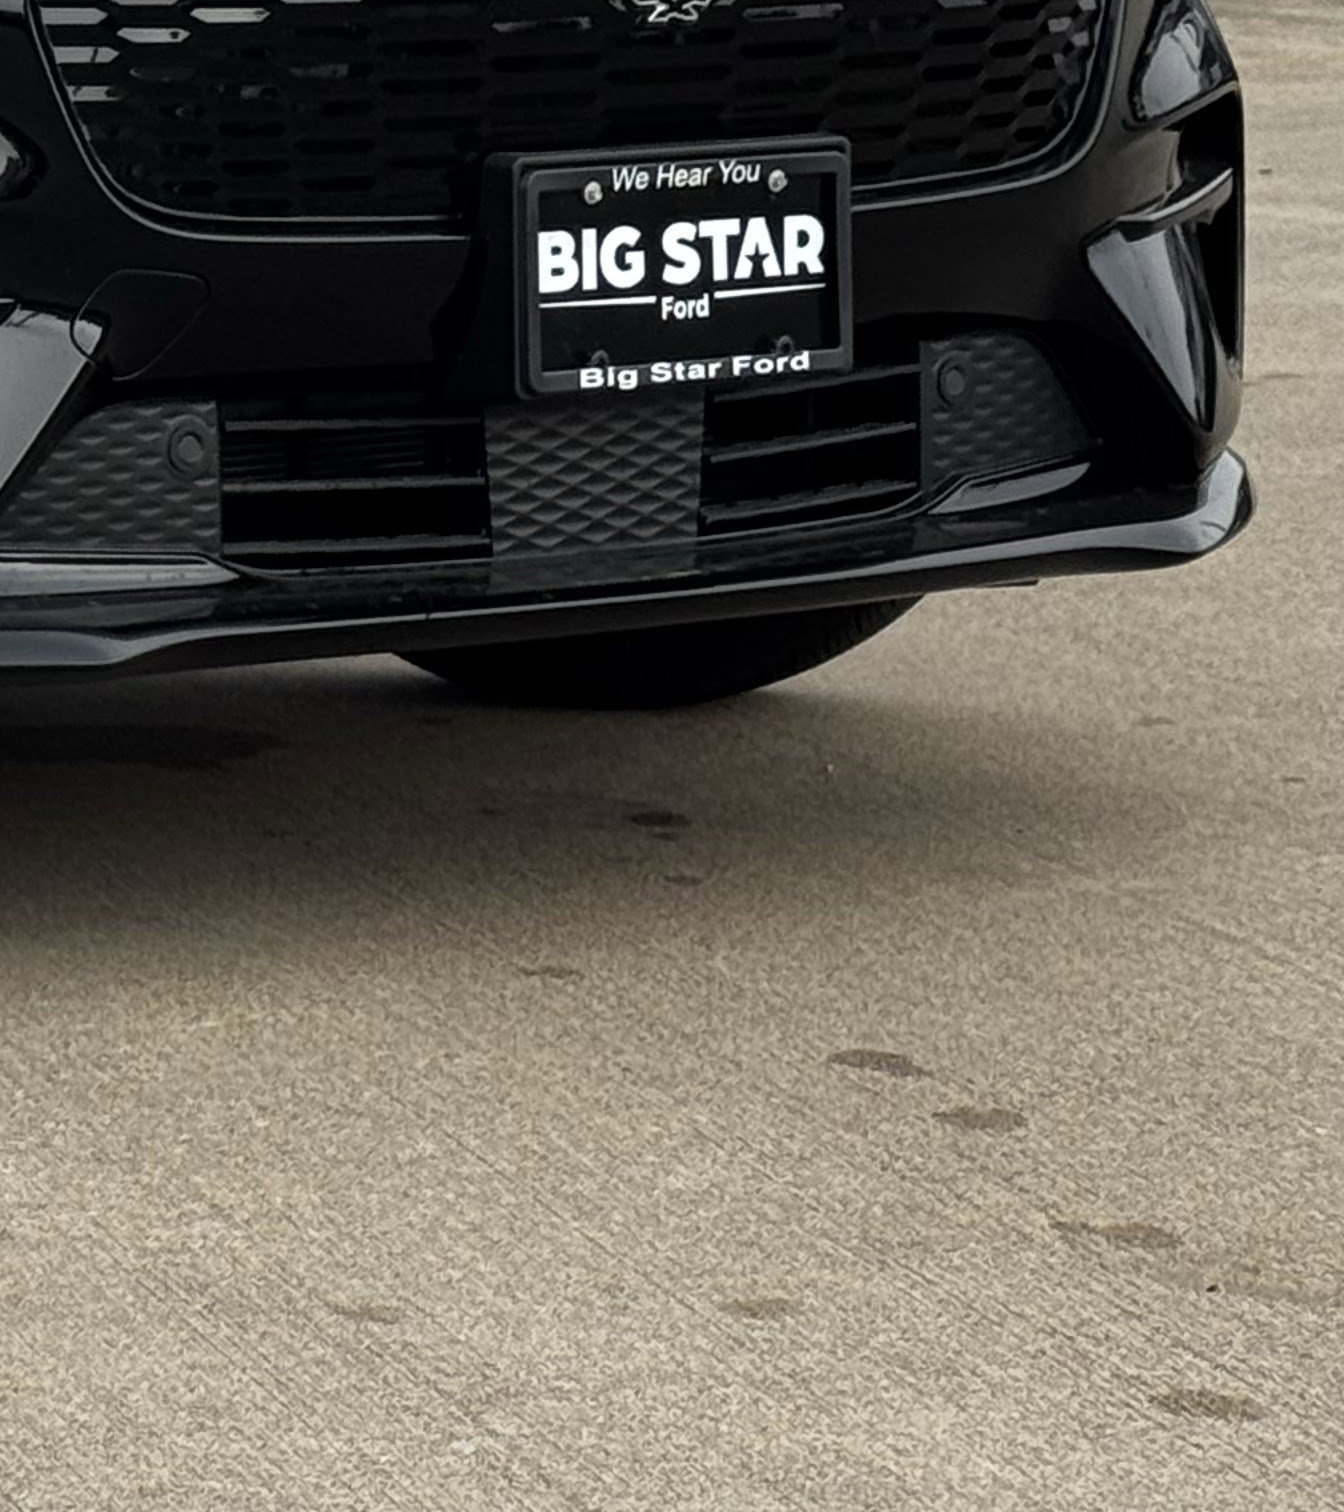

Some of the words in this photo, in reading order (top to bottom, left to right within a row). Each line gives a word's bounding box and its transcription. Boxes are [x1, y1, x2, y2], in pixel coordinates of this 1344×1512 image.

[612, 165, 650, 192] We
[655, 161, 715, 189] Hear
[718, 158, 762, 185] You
[537, 225, 646, 293] BIG
[661, 214, 826, 286] STAR
[660, 292, 711, 321] Ford
[579, 366, 639, 390] Big
[650, 360, 723, 384] Star
[732, 349, 811, 377] Ford
